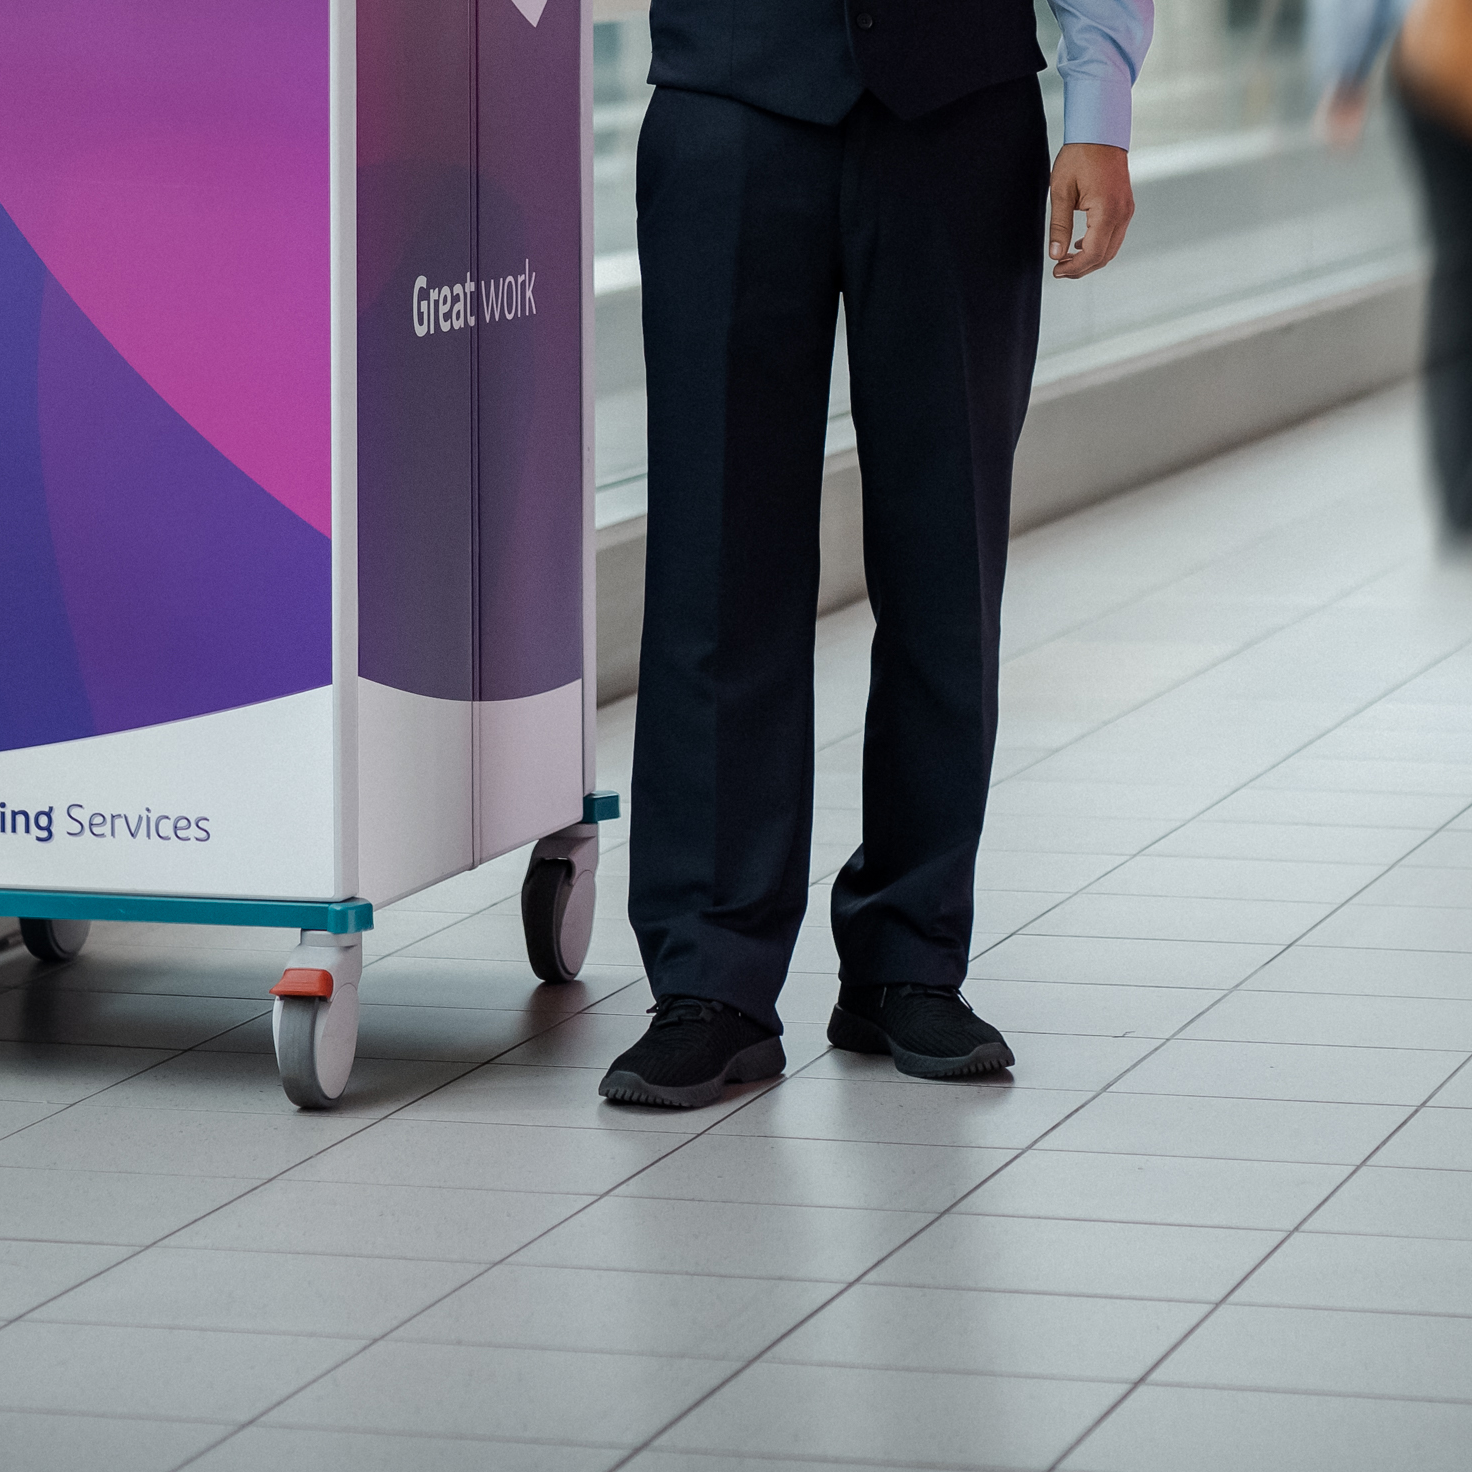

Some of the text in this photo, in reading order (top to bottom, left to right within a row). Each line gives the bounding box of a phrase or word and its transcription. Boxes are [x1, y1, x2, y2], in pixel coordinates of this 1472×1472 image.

[413, 258, 537, 337] Great work
[66, 803, 212, 842] Services
